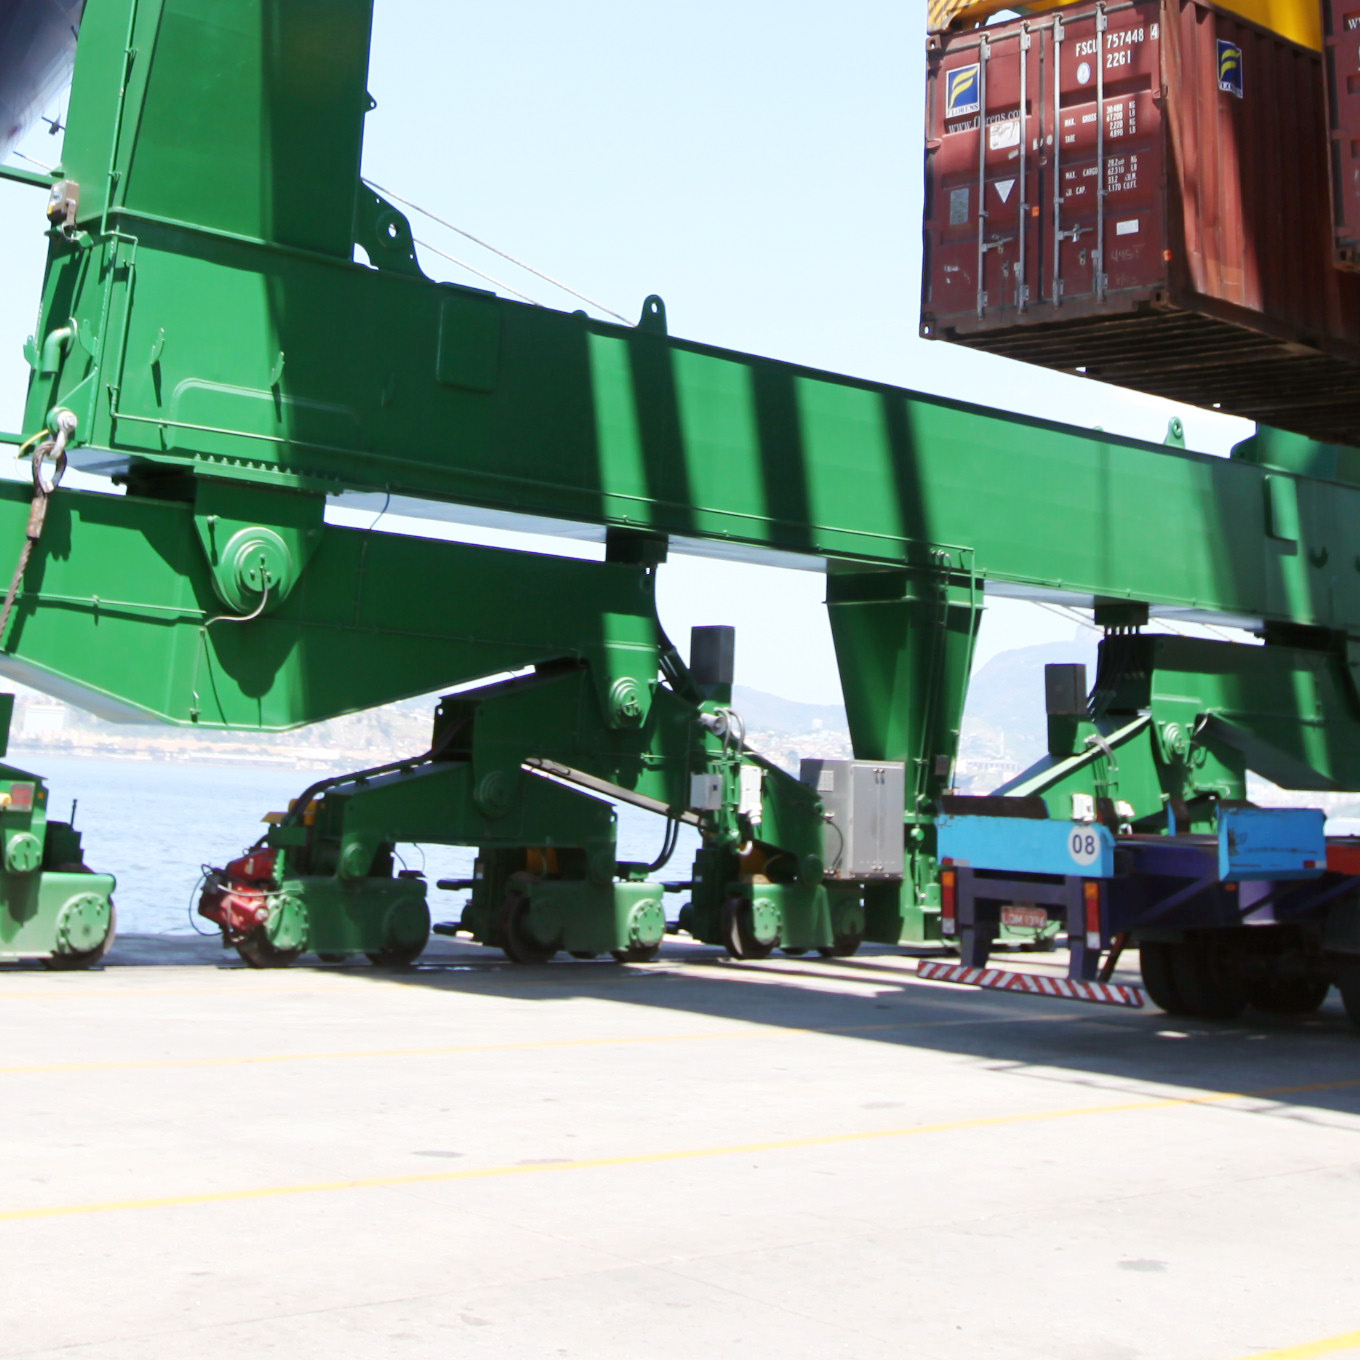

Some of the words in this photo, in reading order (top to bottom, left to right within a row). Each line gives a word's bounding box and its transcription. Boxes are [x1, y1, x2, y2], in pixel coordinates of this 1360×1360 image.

[1106, 28, 1144, 49] 757448
[1150, 23, 1159, 40] 4
[1106, 50, 1131, 68] 22G1
[947, 103, 979, 117] FLORENS
[1082, 113, 1097, 124] GROSS
[948, 110, 1021, 134] www.flrens.co
[1072, 834, 1095, 855] 08
